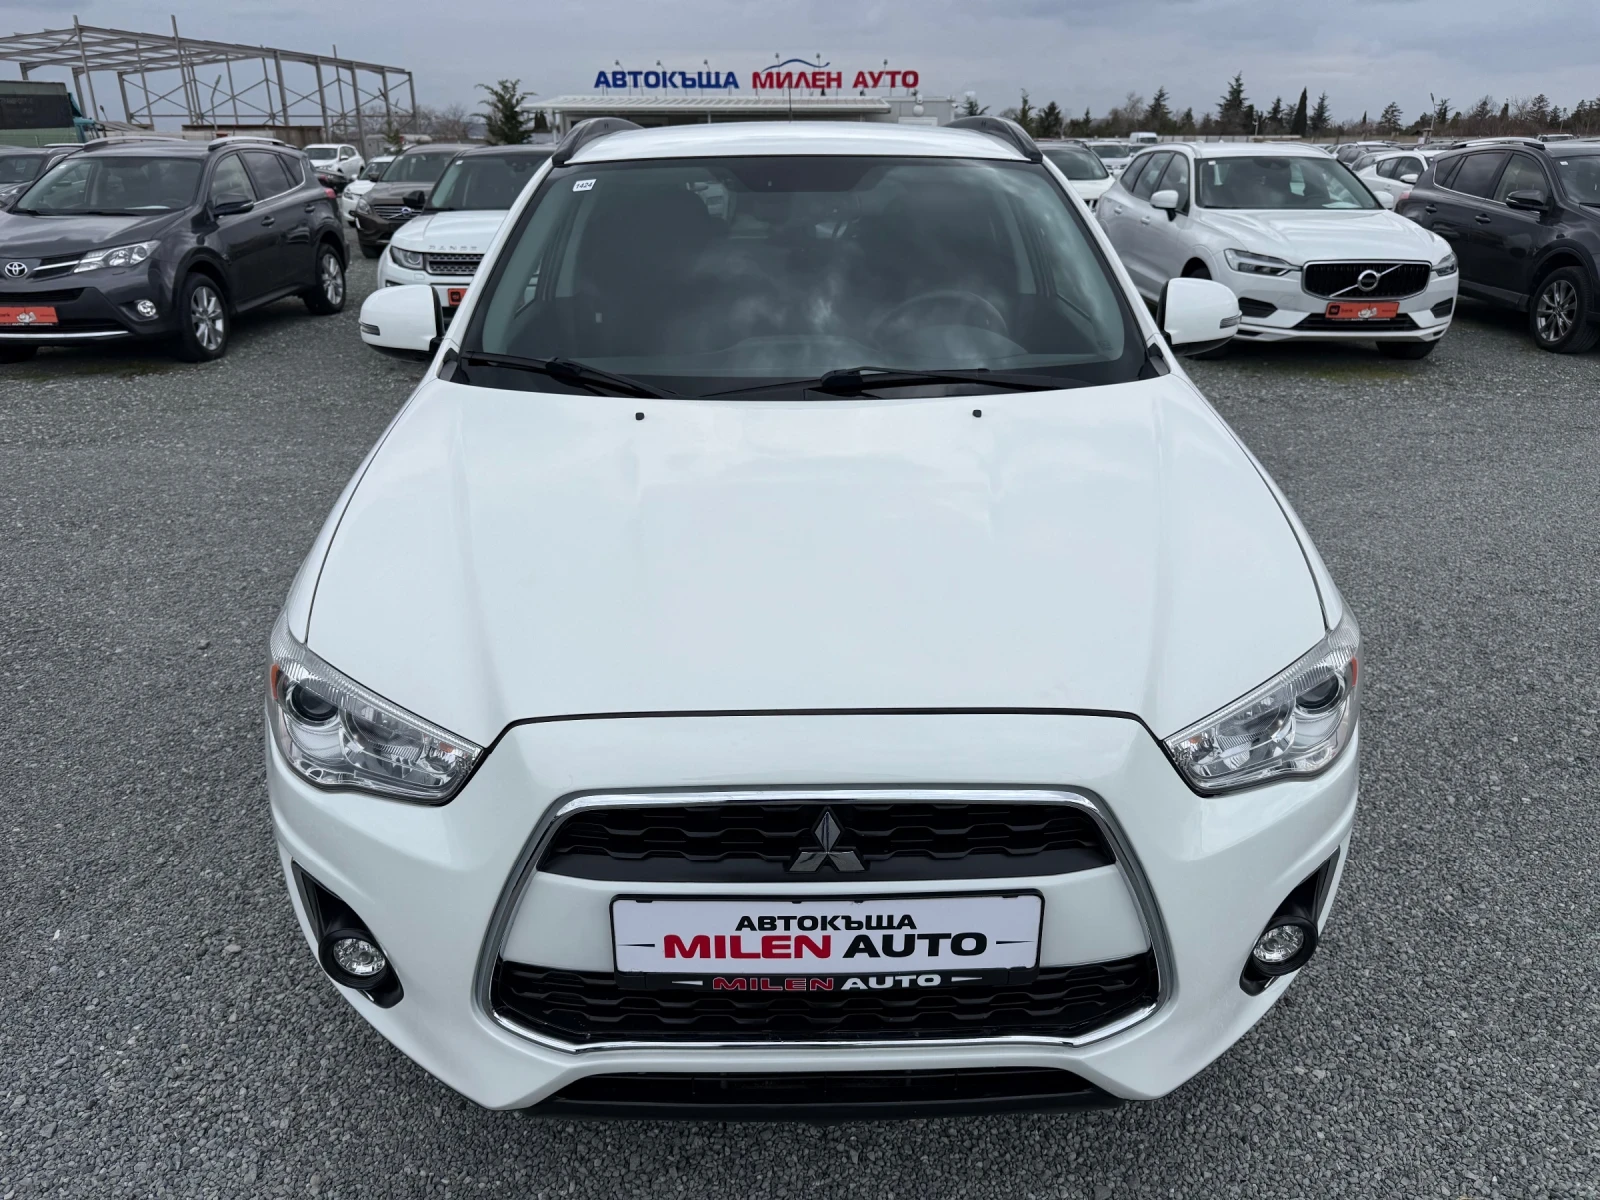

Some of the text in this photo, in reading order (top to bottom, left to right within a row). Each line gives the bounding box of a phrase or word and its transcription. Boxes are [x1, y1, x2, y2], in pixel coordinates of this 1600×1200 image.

[752, 71, 842, 89] МИЛЕН
[853, 71, 919, 89] АУТО
[664, 932, 988, 959] MILEN AUTO
[712, 974, 942, 991] MILEN AUTO
